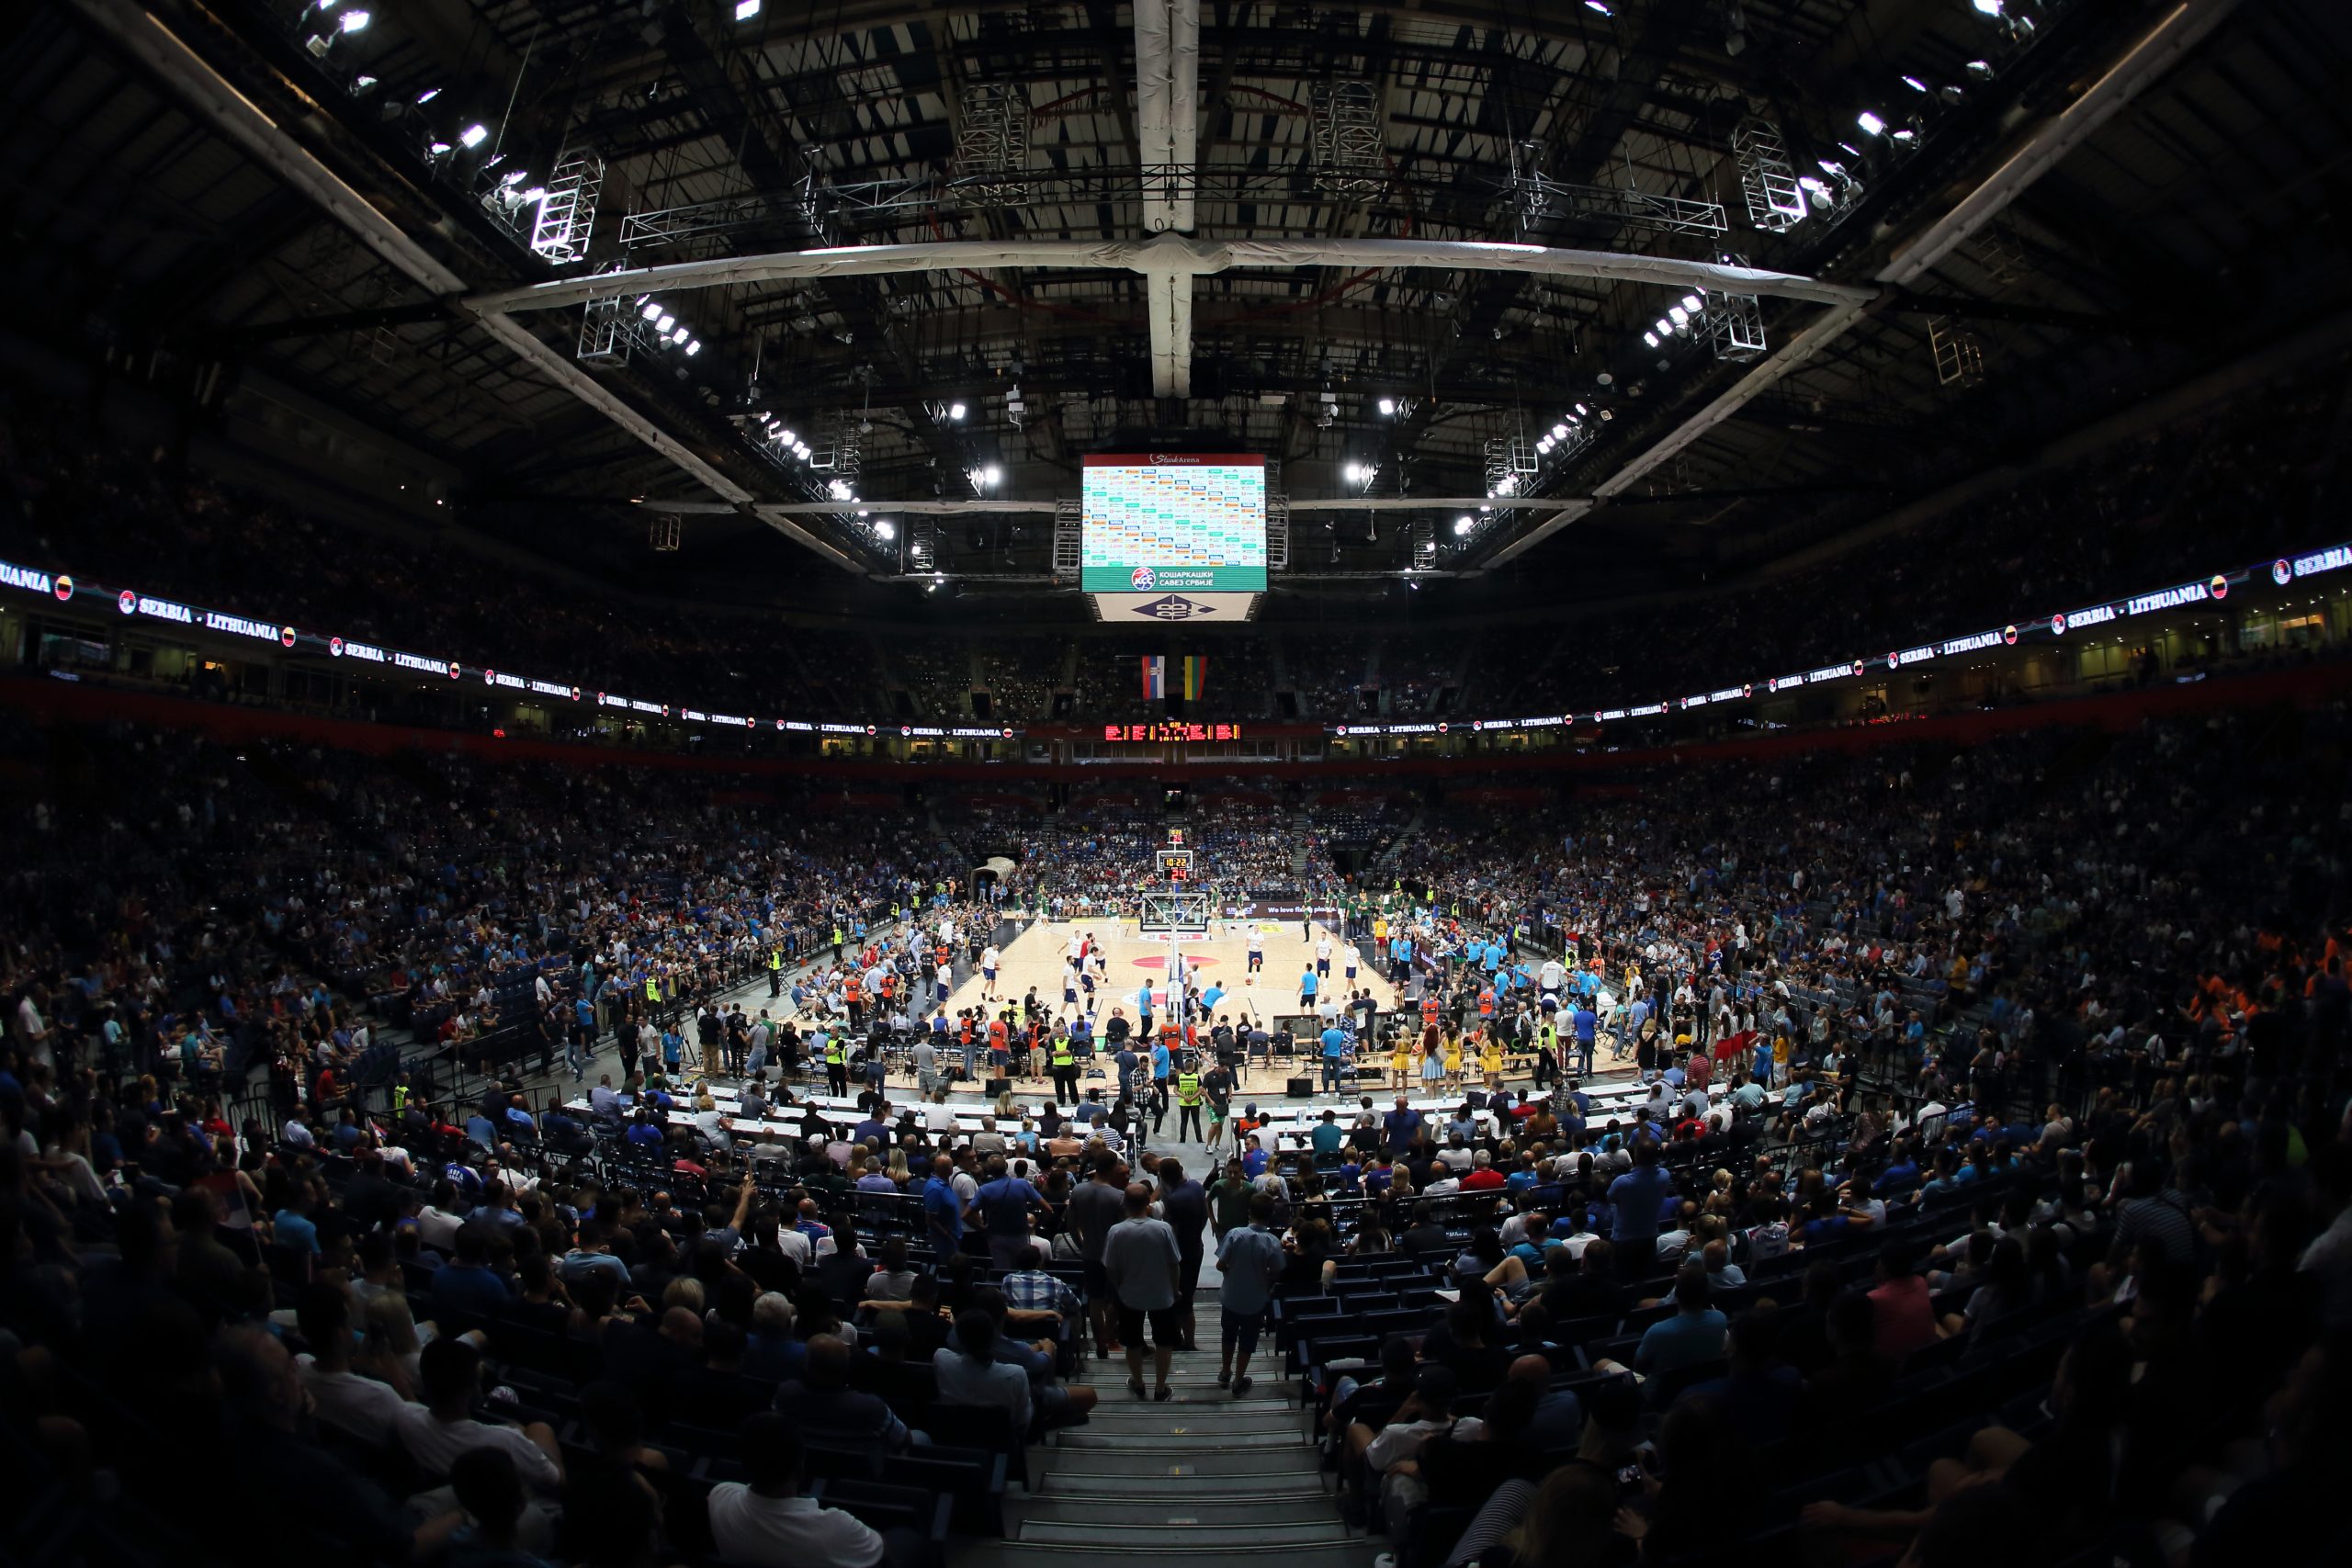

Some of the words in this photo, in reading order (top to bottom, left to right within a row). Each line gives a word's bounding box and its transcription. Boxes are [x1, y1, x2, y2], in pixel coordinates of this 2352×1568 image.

[2067, 605, 2116, 629] SERBIA
[2128, 582, 2209, 615] LITHUANIA
[139, 598, 192, 623] SERBIA
[207, 613, 279, 640] LITHUANIA
[1899, 646, 1935, 664] SERBIA
[1943, 630, 2003, 655] LITHUANIA
[345, 643, 384, 662] SERBIA
[395, 653, 447, 674] LITHUANIA
[496, 673, 525, 689] SERBIA
[532, 681, 571, 697] LITHUANIA
[1778, 674, 1804, 689] SERBIA
[1810, 664, 1853, 682] LITHUANIA
[606, 695, 628, 707] SERBIA
[632, 701, 662, 714] LITHUANIA
[1687, 694, 1707, 706] SERBIA
[1711, 687, 1743, 703] LITHUANIA
[687, 711, 706, 721] SERBIA
[712, 715, 747, 726] LITHUANIA
[1602, 710, 1625, 720] SERBIA
[1631, 705, 1662, 717] LITHUANIA
[786, 721, 812, 730] SERBIA
[820, 724, 865, 733] LITHUANIA
[1348, 726, 1381, 734] SERBIA
[1389, 724, 1437, 733] LITHUANIA
[1483, 720, 1513, 729] SERBIA
[1521, 716, 1563, 727] LITHUANIA
[912, 728, 944, 736] SERBIA
[952, 728, 1001, 737] LITHUANIA
[1166, 858, 1186, 866] 10:22
[1171, 869, 1186, 881] 24
